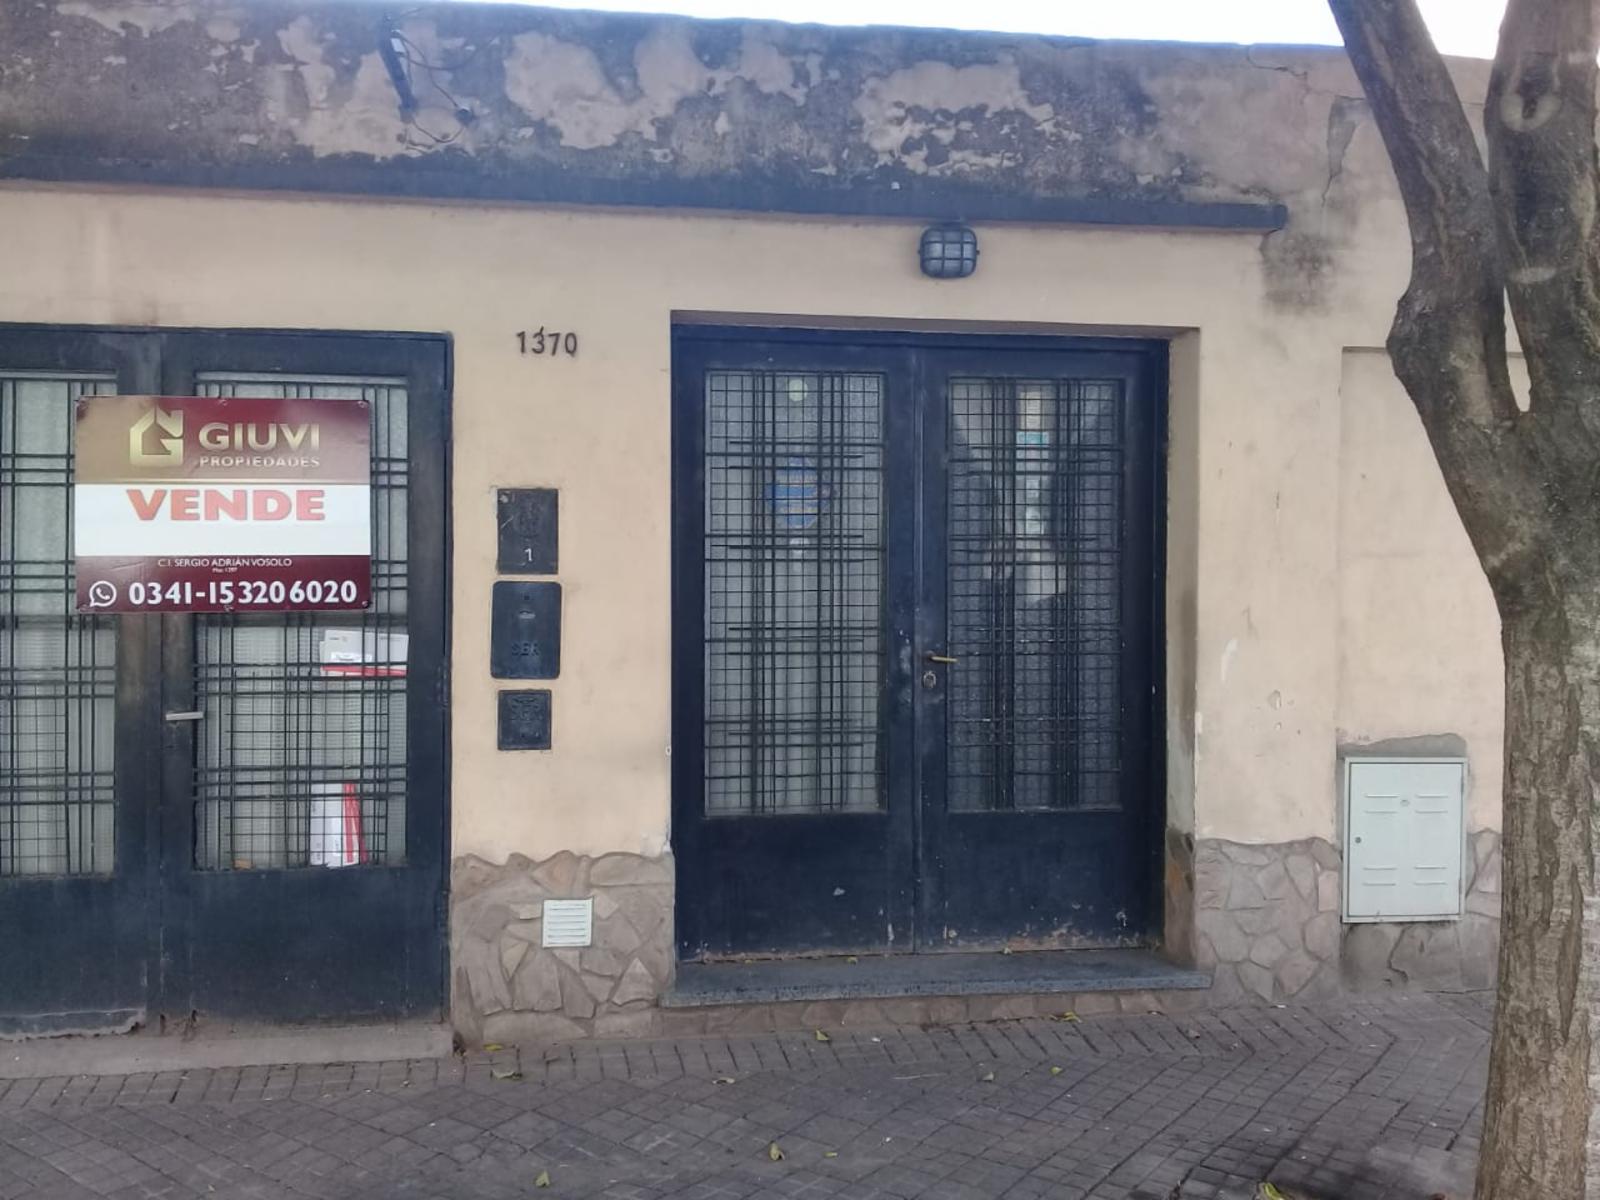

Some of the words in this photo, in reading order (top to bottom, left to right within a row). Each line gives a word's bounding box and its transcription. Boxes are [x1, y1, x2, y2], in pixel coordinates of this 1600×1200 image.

[516, 326, 577, 357] 1370
[198, 422, 320, 451] GIUVI
[200, 456, 320, 468] PROPIEDADES
[126, 489, 326, 521] VENDE
[174, 558, 210, 568] SERGIO
[250, 558, 293, 567] VOSOLO
